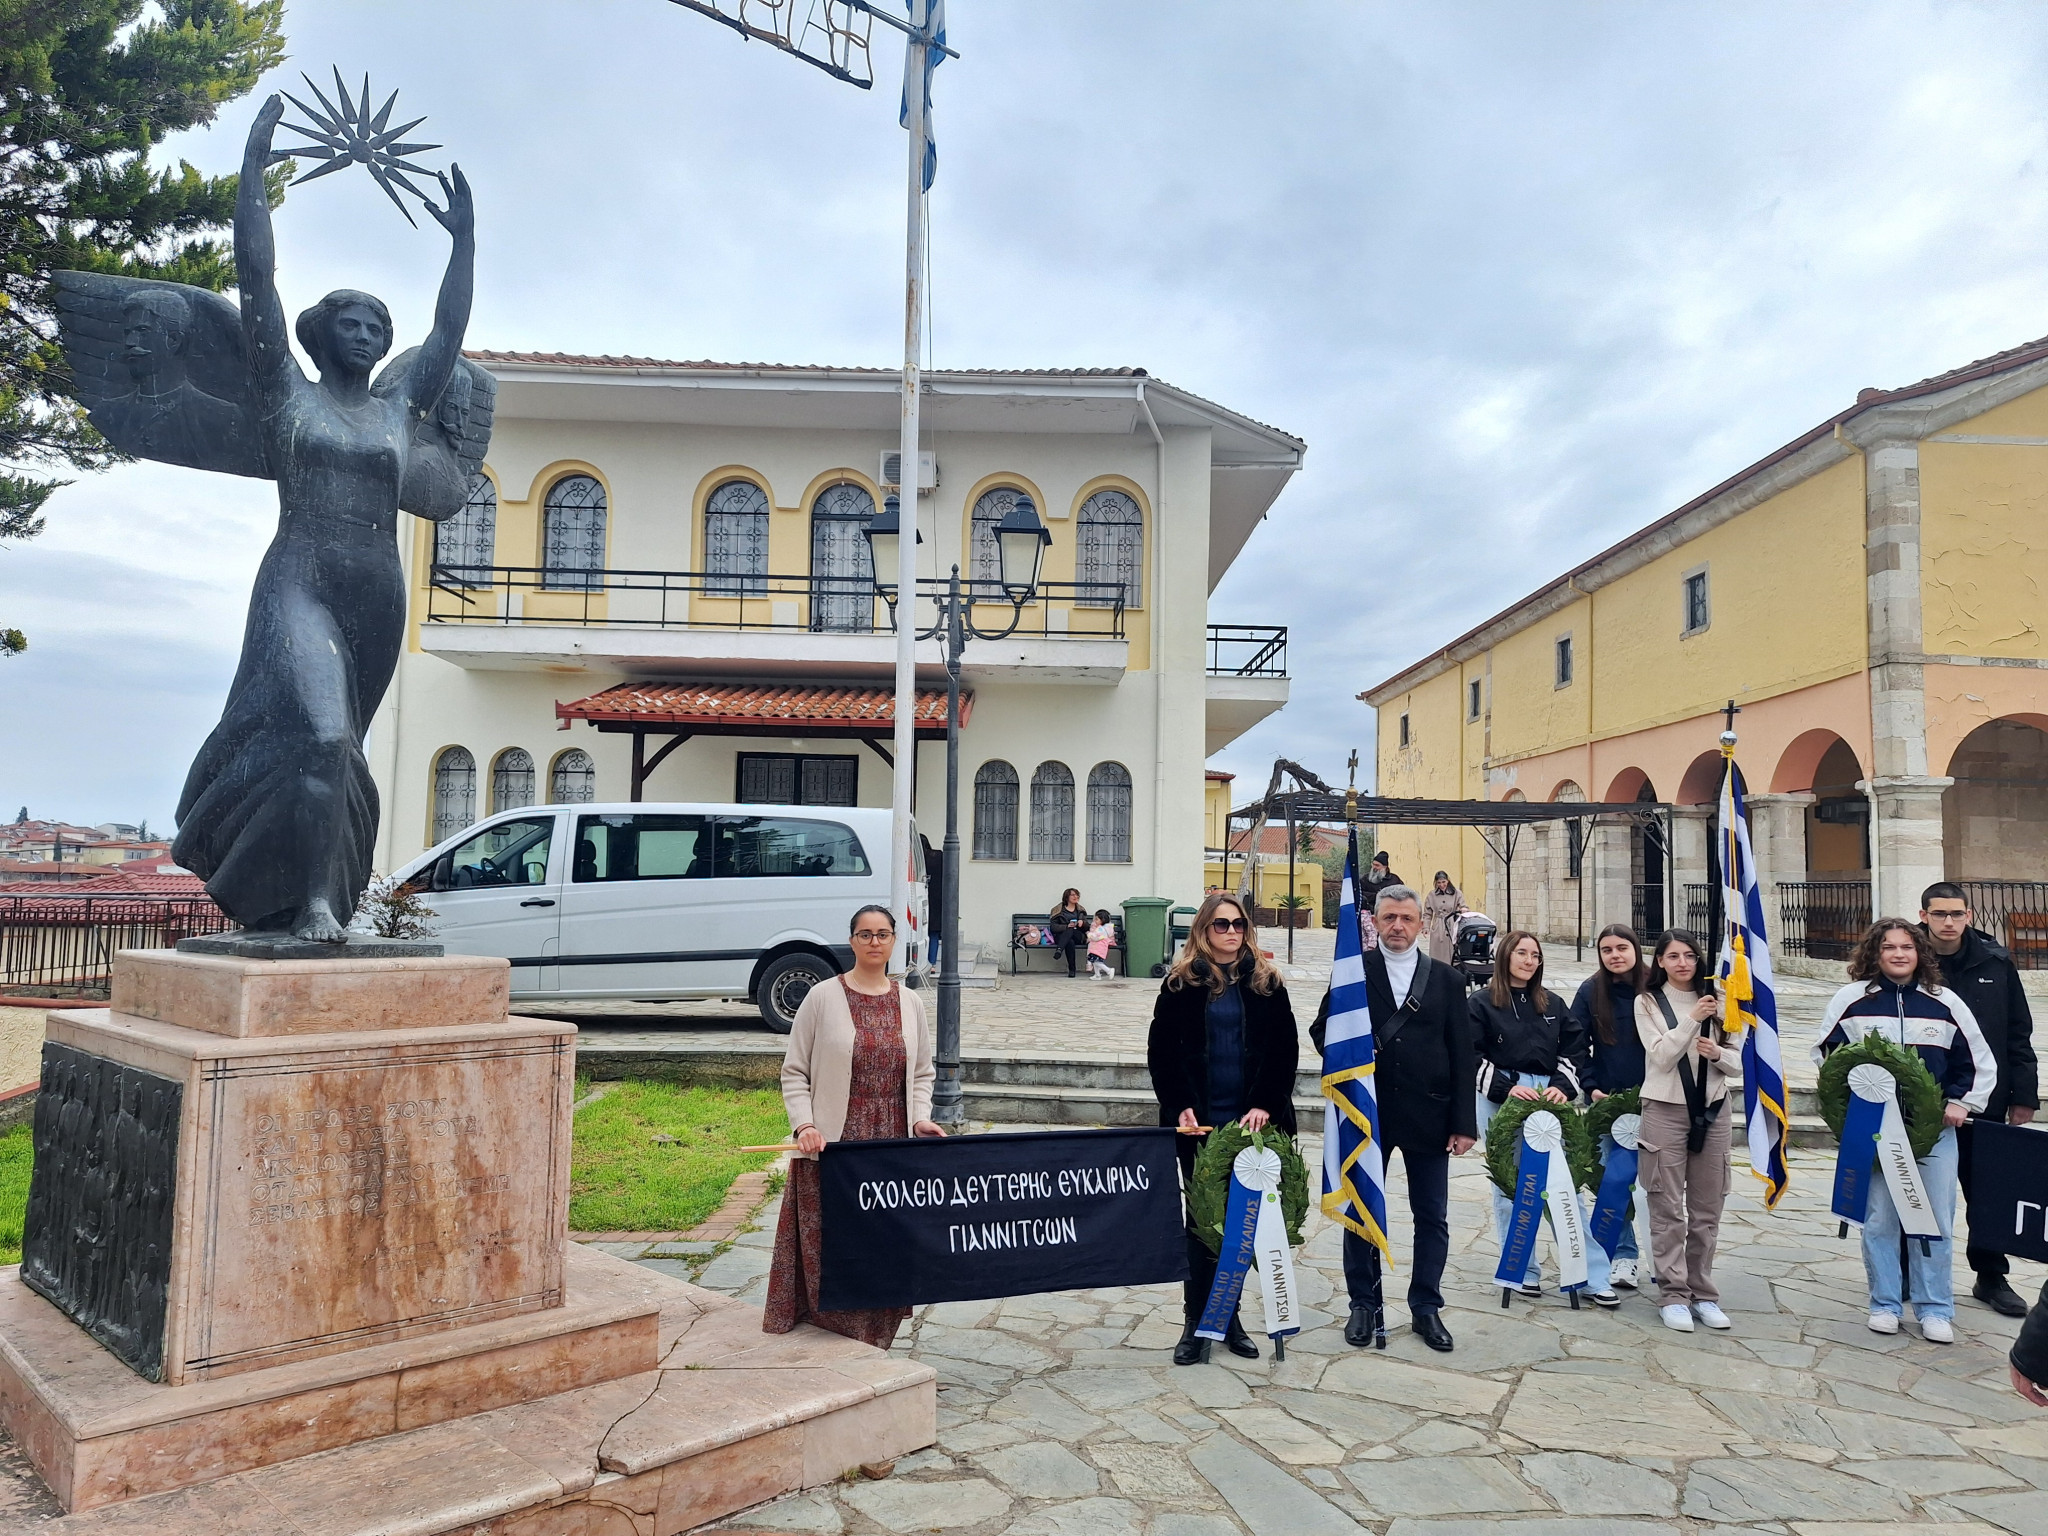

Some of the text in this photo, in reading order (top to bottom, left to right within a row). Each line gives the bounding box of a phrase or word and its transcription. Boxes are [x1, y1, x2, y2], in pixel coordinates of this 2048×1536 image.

[253, 1116, 476, 1158] ΚΑΙ Η ΘΥΣΙΑ ΤΟΥΣ
[255, 1098, 447, 1134] ΟΙ ΗΡΩΕΣ ΖΟΥΝ
[251, 1160, 460, 1203] ΟΤΑΝ ΥΠΑΡΧΟΥΝ
[252, 1145, 408, 1181] ΔΙΚΑΙΩΝΕΤΑΙ
[1889, 1141, 1923, 1210] ΓΙΑΝΝΙΤΣΩΝ
[249, 1193, 379, 1227] ΣΕΒΑΣΜΟΣ
[859, 1164, 1150, 1211] ΣΧΟΛΕΙΟ ΔΕΥΤΕΡΗΣ ΕΥΚΑΙΡΙΑΣ
[1521, 1173, 1538, 1207] ΕΠΑΛ
[1558, 1190, 1580, 1259] ΓΙΑΝΝΙΤΣΩΝ
[1214, 1198, 1260, 1331] ΔΕΥΤΕΡΗΣ ΕΥΚΑΙΡΙΑΣ
[1269, 1249, 1290, 1323] ΓΙΑΝΝΙΤΣΩΝ
[1202, 1271, 1230, 1325] ΣΧΟΛΕΙΟ
